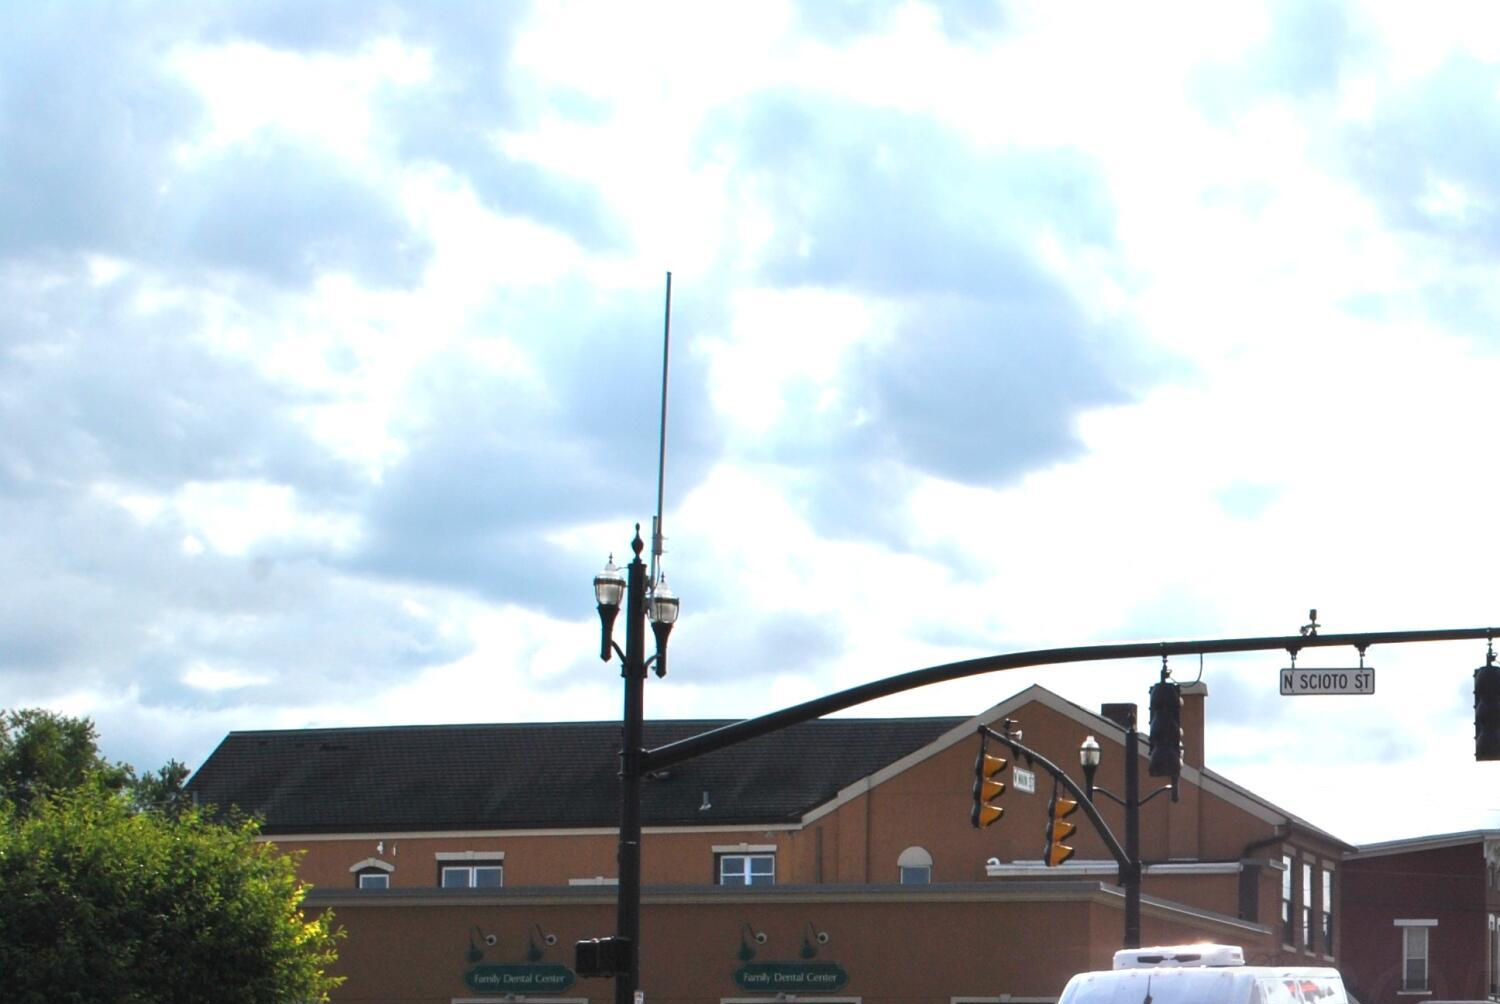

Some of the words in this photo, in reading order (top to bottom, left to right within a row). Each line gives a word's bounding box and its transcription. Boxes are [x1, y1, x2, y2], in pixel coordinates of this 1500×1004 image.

[1284, 673, 1293, 689] N
[1300, 673, 1348, 689] SCIOTO
[1354, 673, 1370, 689] ST
[474, 973, 500, 985] Family
[503, 973, 533, 984] Dental
[535, 973, 565, 983] Center
[744, 972, 770, 984] Family
[774, 972, 804, 983] Dental
[806, 972, 838, 983] Center
